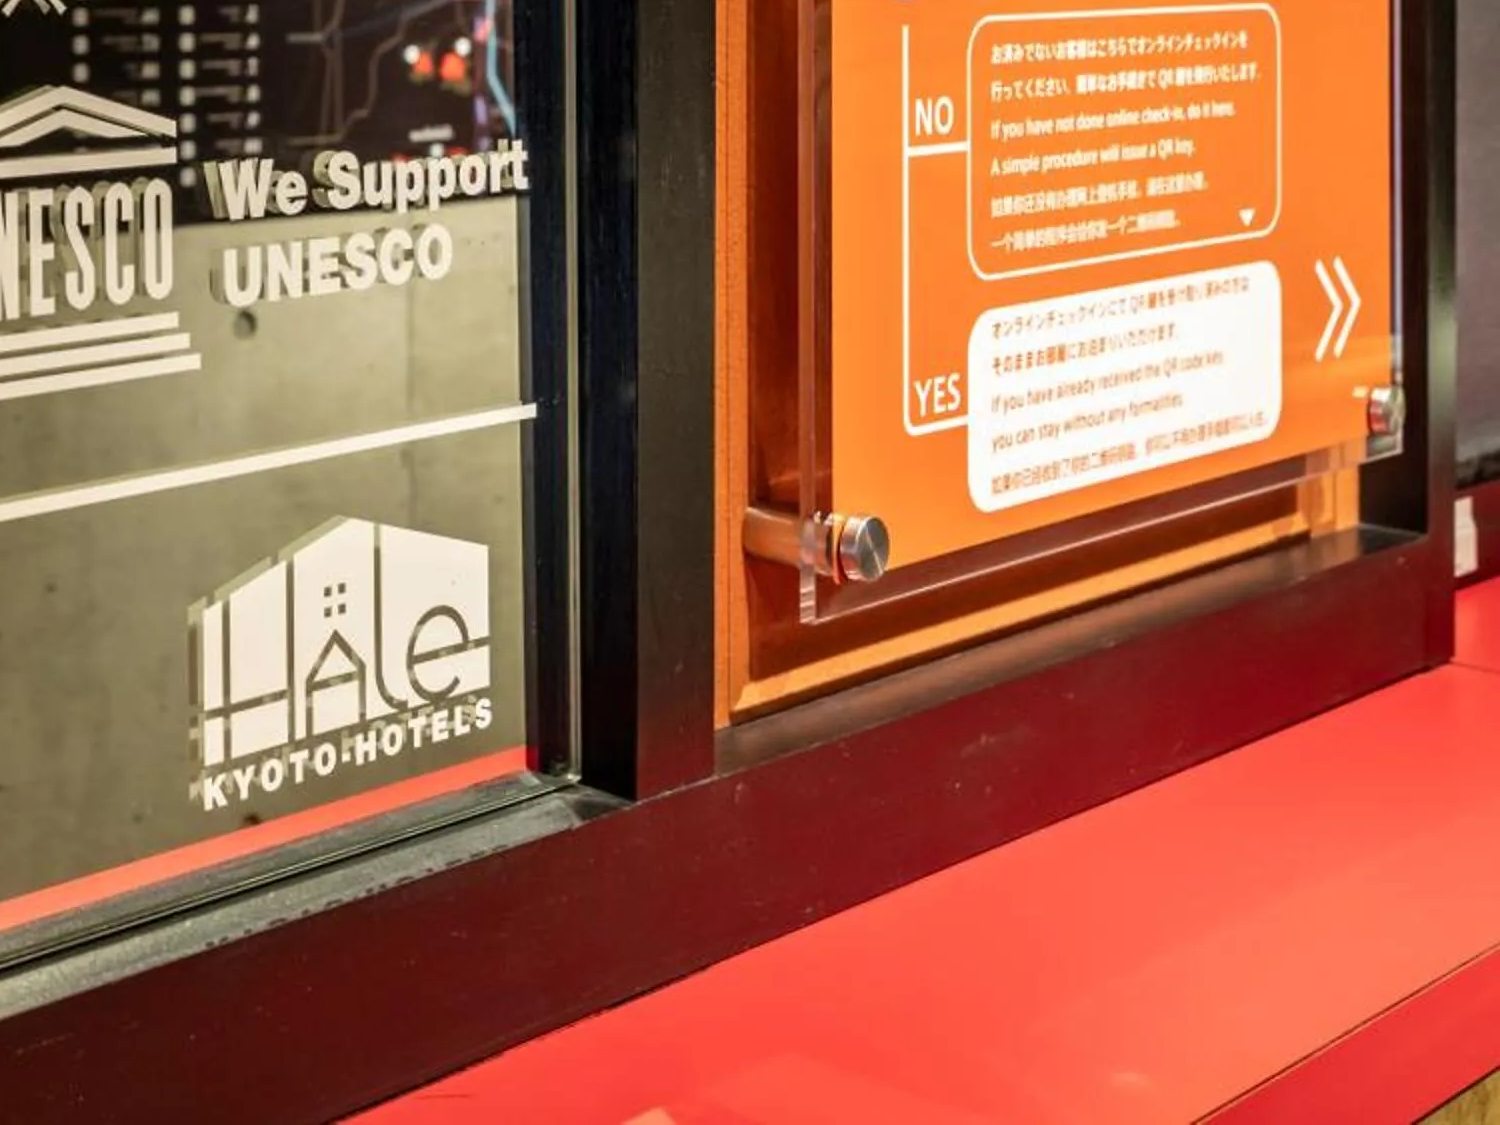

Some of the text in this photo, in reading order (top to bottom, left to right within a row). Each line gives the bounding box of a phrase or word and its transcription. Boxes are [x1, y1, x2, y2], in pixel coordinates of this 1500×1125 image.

[914, 96, 955, 137] NO
[1002, 121, 1024, 142] you
[218, 139, 529, 221] We Support
[990, 158, 1001, 176] A
[1002, 154, 1040, 176] simple
[224, 224, 453, 307] UNESCO
[914, 373, 962, 417] YES
[1002, 392, 1025, 415] you
[1026, 387, 1054, 408] have
[1056, 379, 1096, 403] already
[991, 432, 1014, 453] you
[1015, 428, 1036, 445] can
[1037, 419, 1060, 442] stay
[1062, 410, 1106, 435] without
[1107, 405, 1127, 425] any
